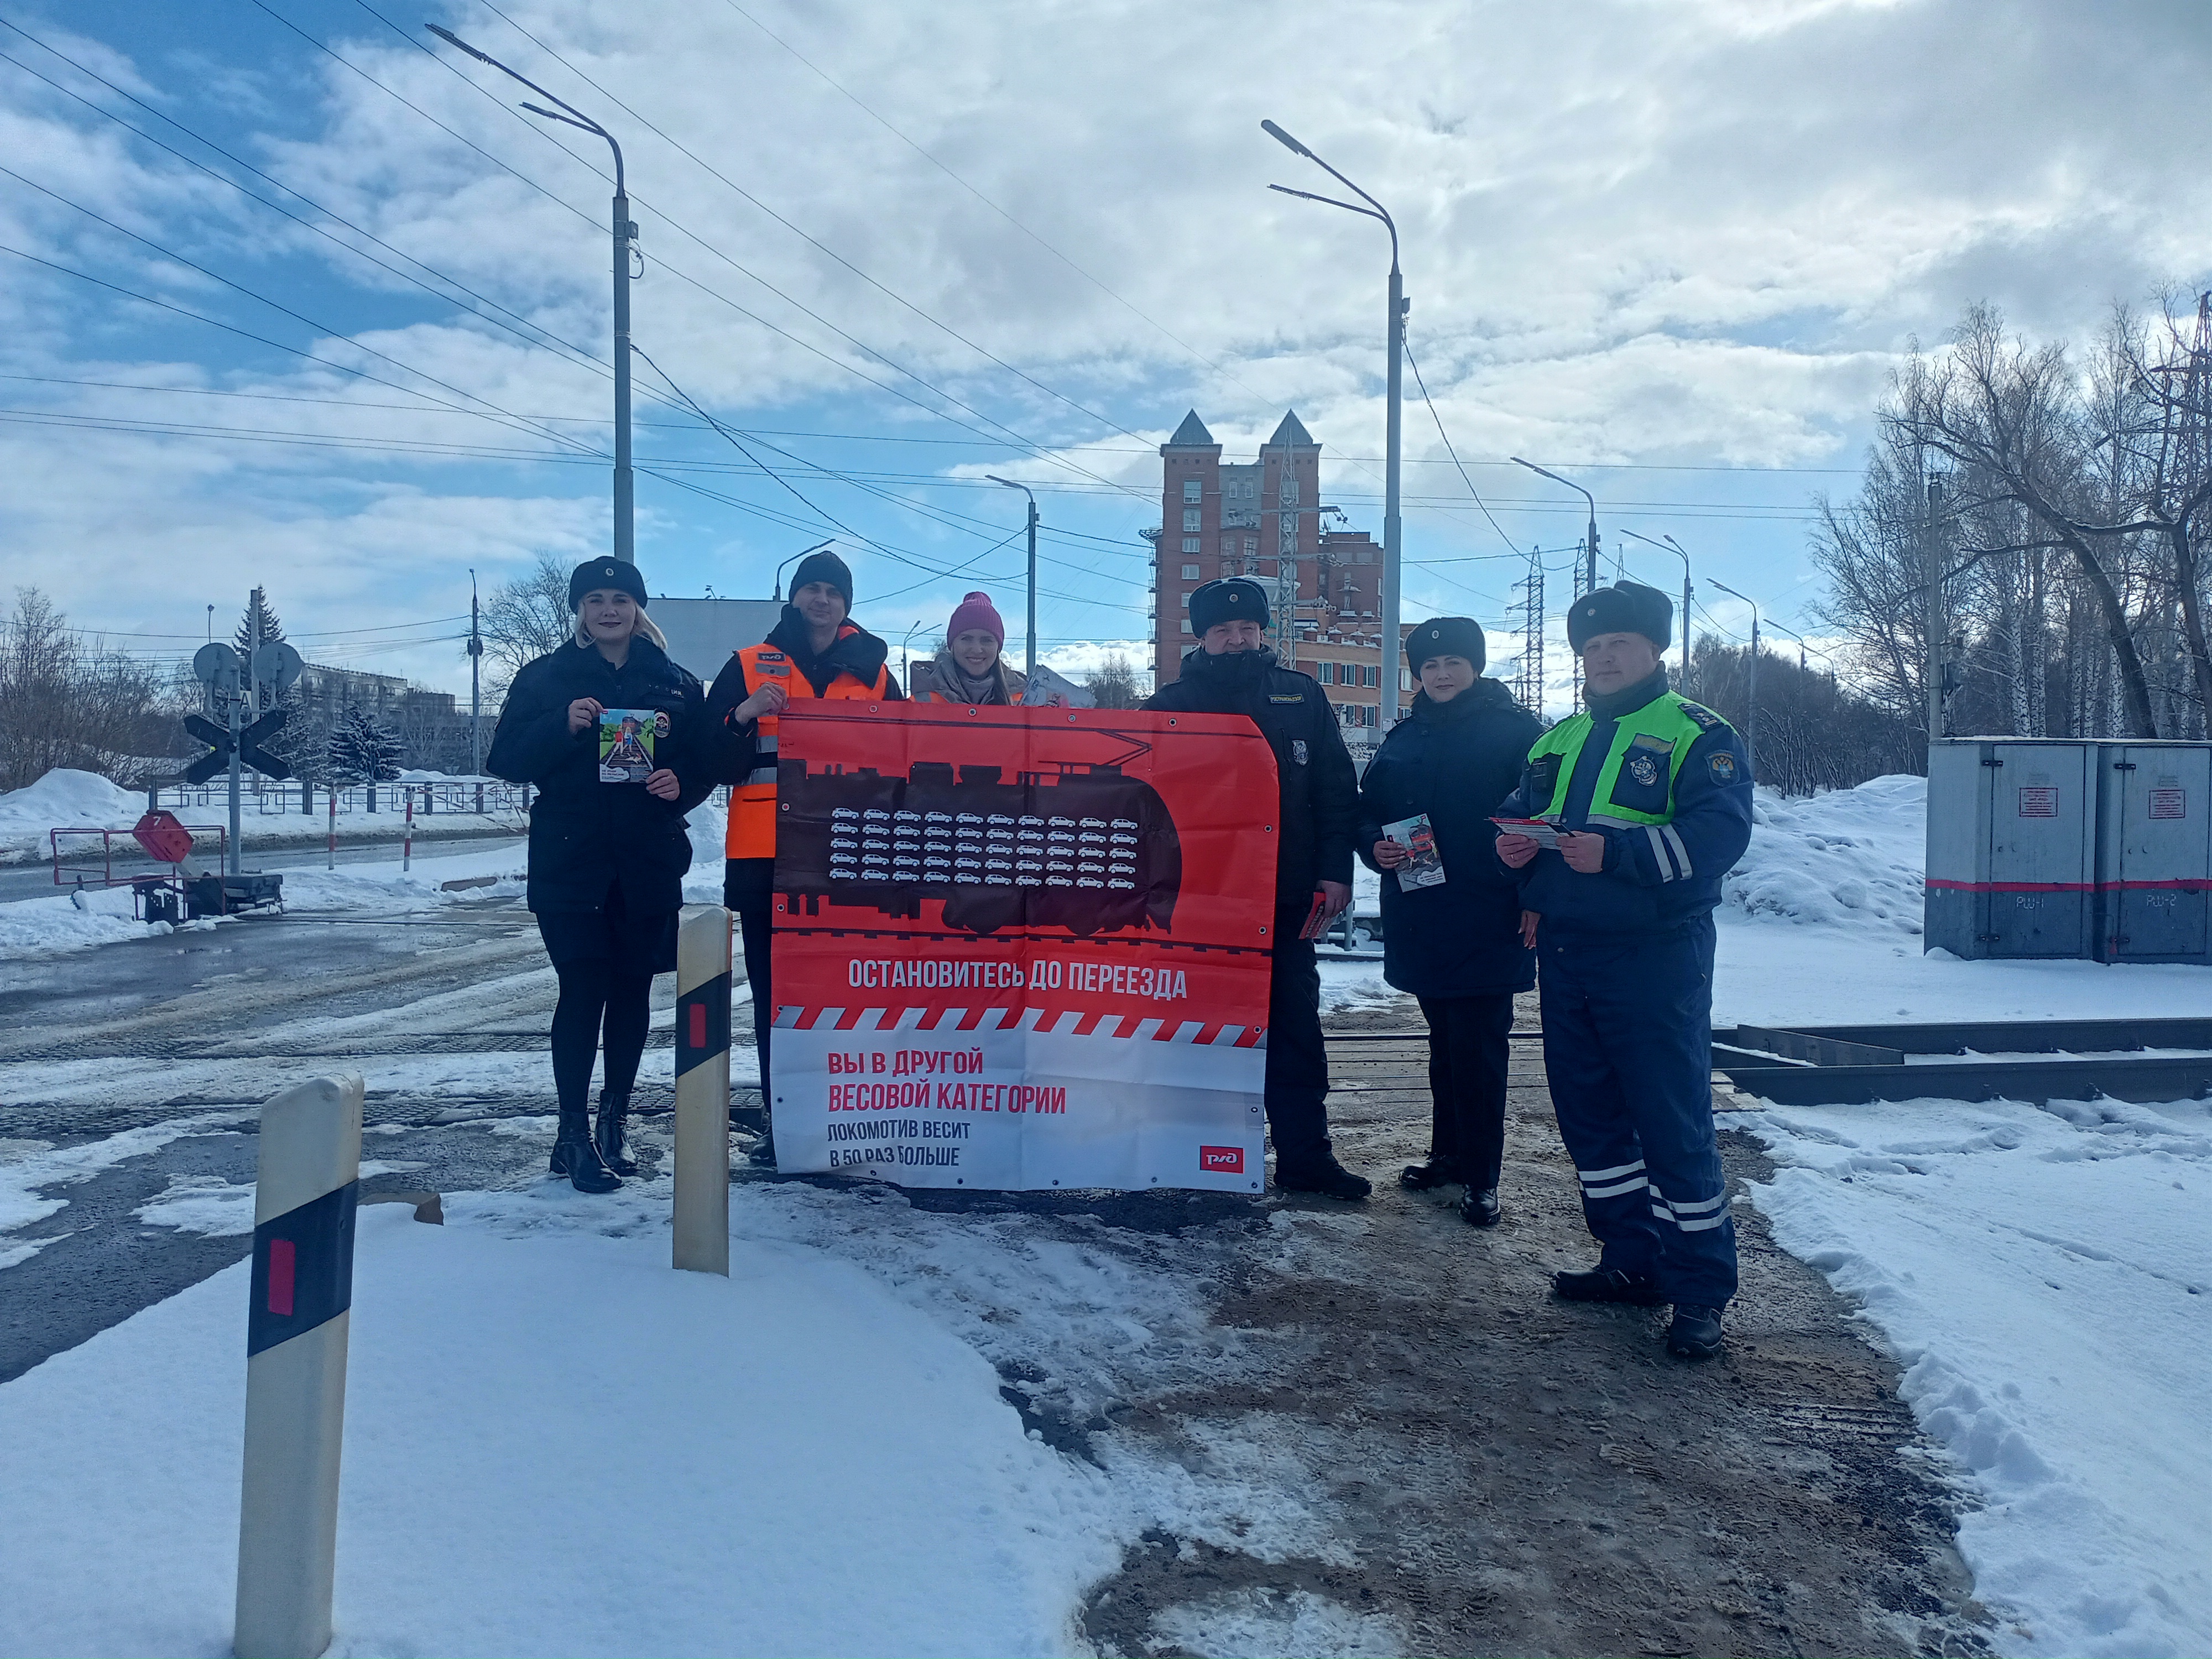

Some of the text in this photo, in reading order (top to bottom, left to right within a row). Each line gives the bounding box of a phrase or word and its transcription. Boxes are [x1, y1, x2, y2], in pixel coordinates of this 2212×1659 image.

[153, 816, 161, 826] 7
[848, 959, 1187, 1001] ОСТАНОВИТЕСЬ ДО ПЕРЕЕЗДА
[828, 1047, 983, 1077] ВЫ В ДРУГОЙ
[828, 1078, 1066, 1114] ВЕСОВОЙ КАТЕГОРИИ
[828, 1119, 971, 1142] ЛОКОМОТИВ ВЕСИТ
[830, 1145, 960, 1167] В 50 РАЗ БОЛЬШЕ
